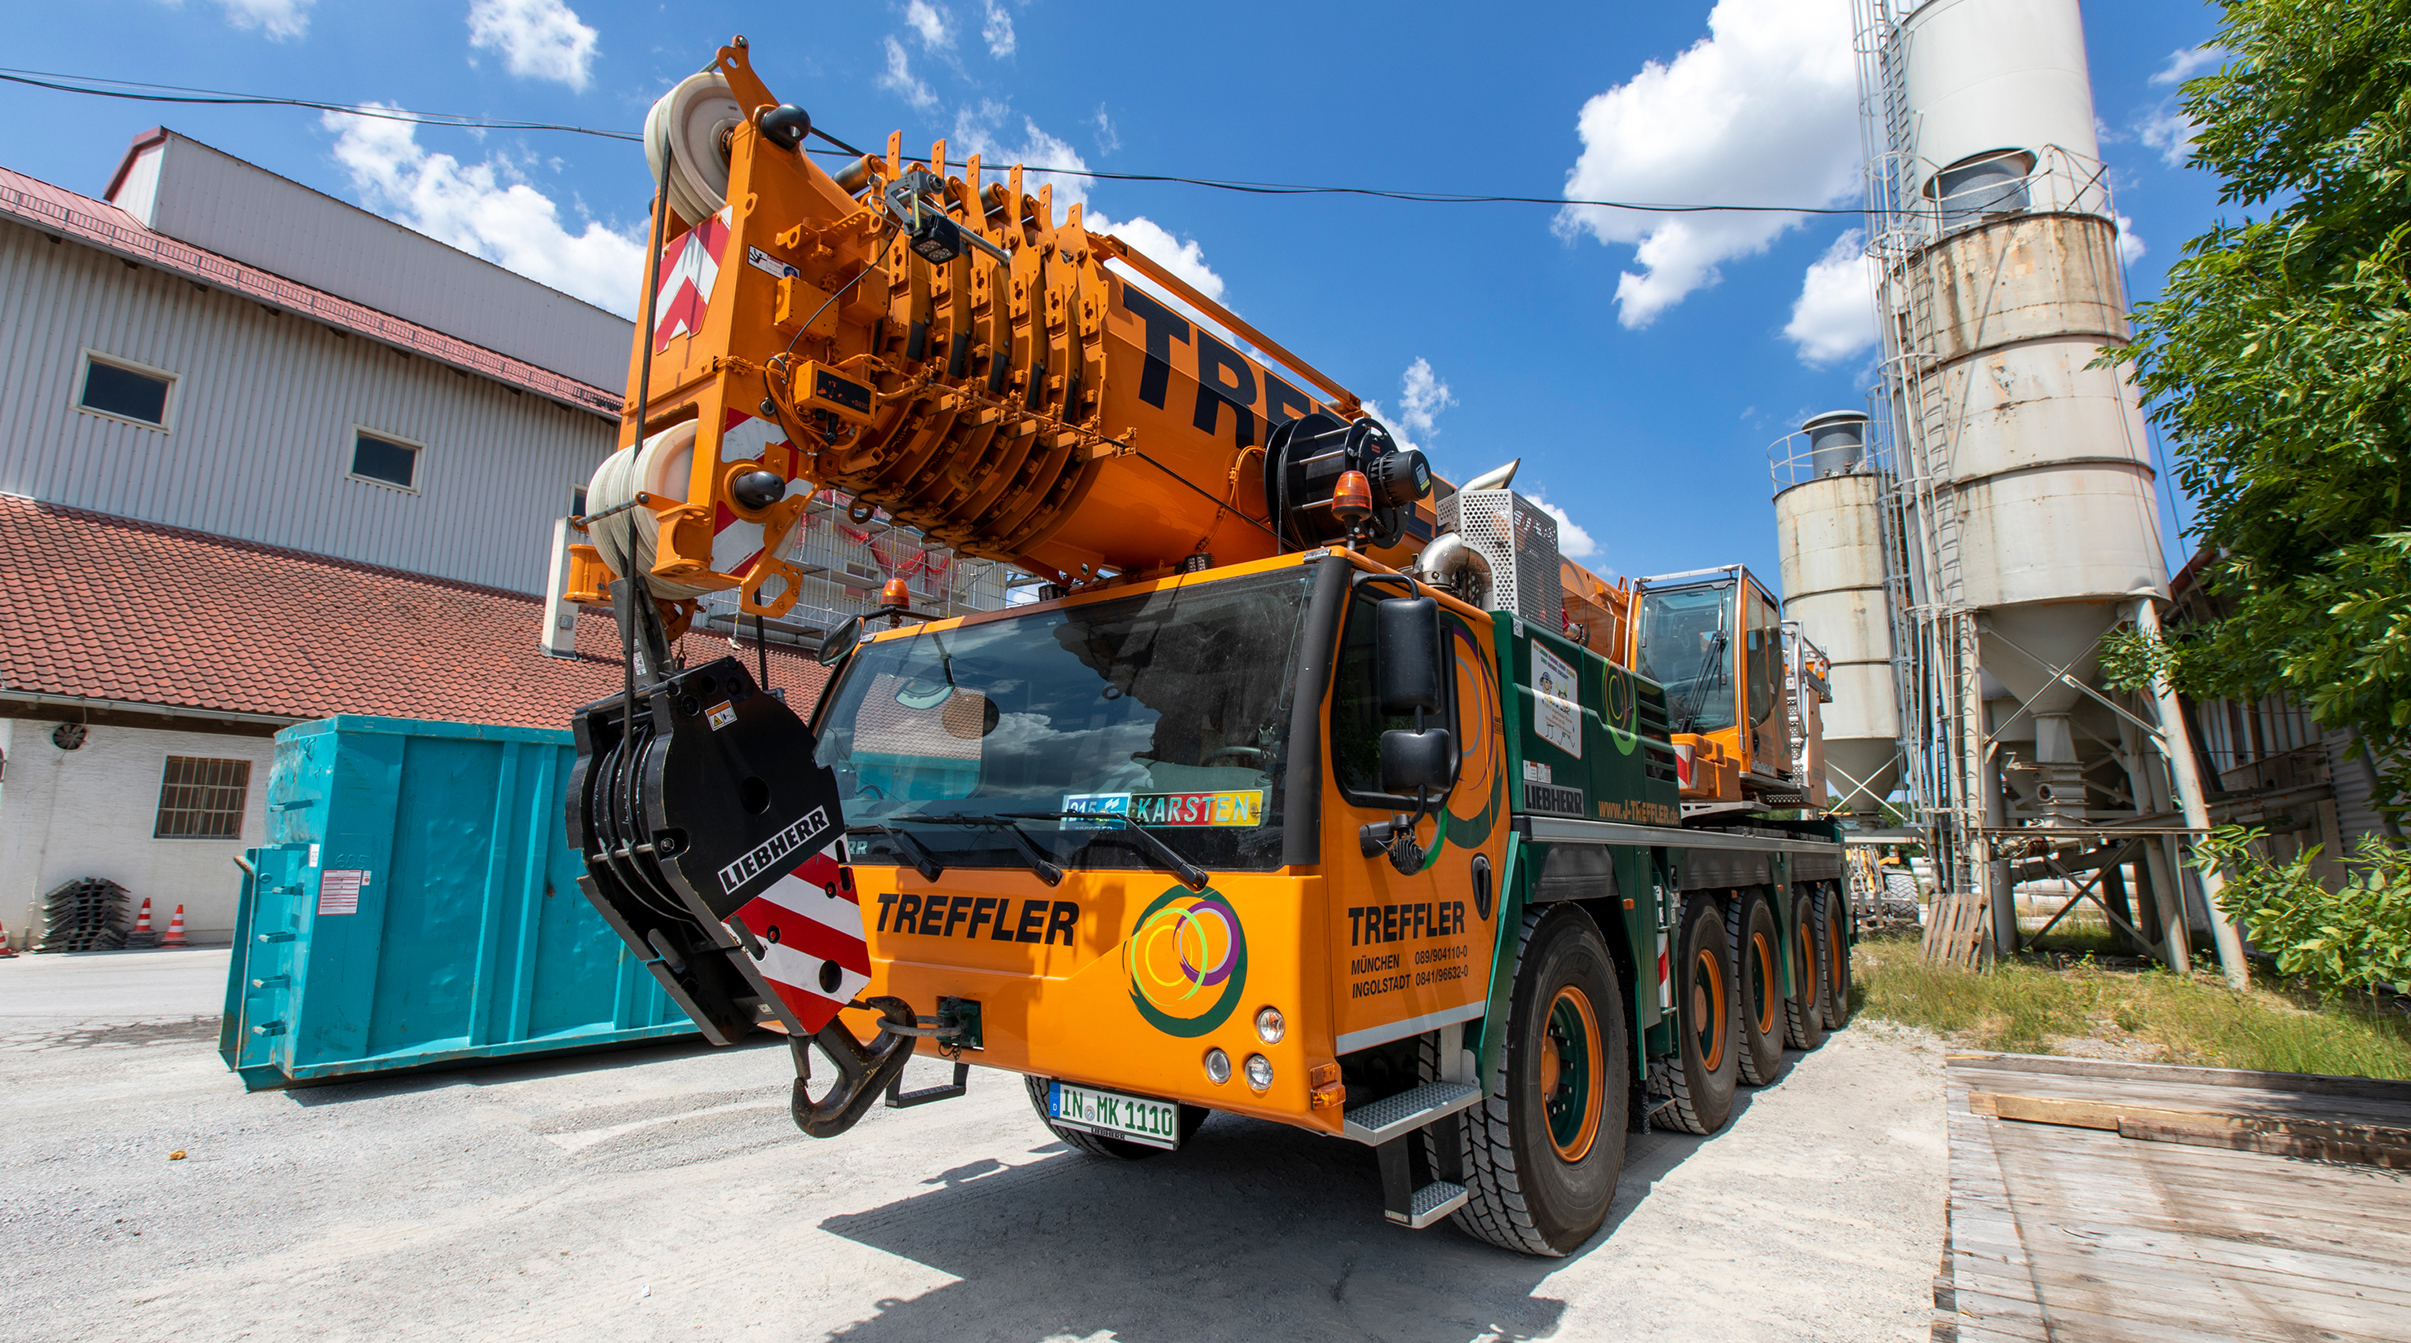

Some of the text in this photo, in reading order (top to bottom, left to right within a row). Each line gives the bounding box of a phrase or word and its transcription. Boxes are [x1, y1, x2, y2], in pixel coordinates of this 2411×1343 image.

[1137, 795, 1249, 822] KARSTEN
[1525, 784, 1583, 814] LIEBHERR
[335, 853, 369, 869] 605
[720, 809, 829, 894] LIEBHERR
[877, 893, 1080, 946] TREFFLER
[1348, 901, 1465, 946] TREFFLER
[1351, 945, 1468, 975] MÜNCHEN 089/904110-0
[1352, 964, 1468, 999] INGOLSTADT 0841/96632-0
[1062, 1089, 1173, 1136] IN MK 1110
